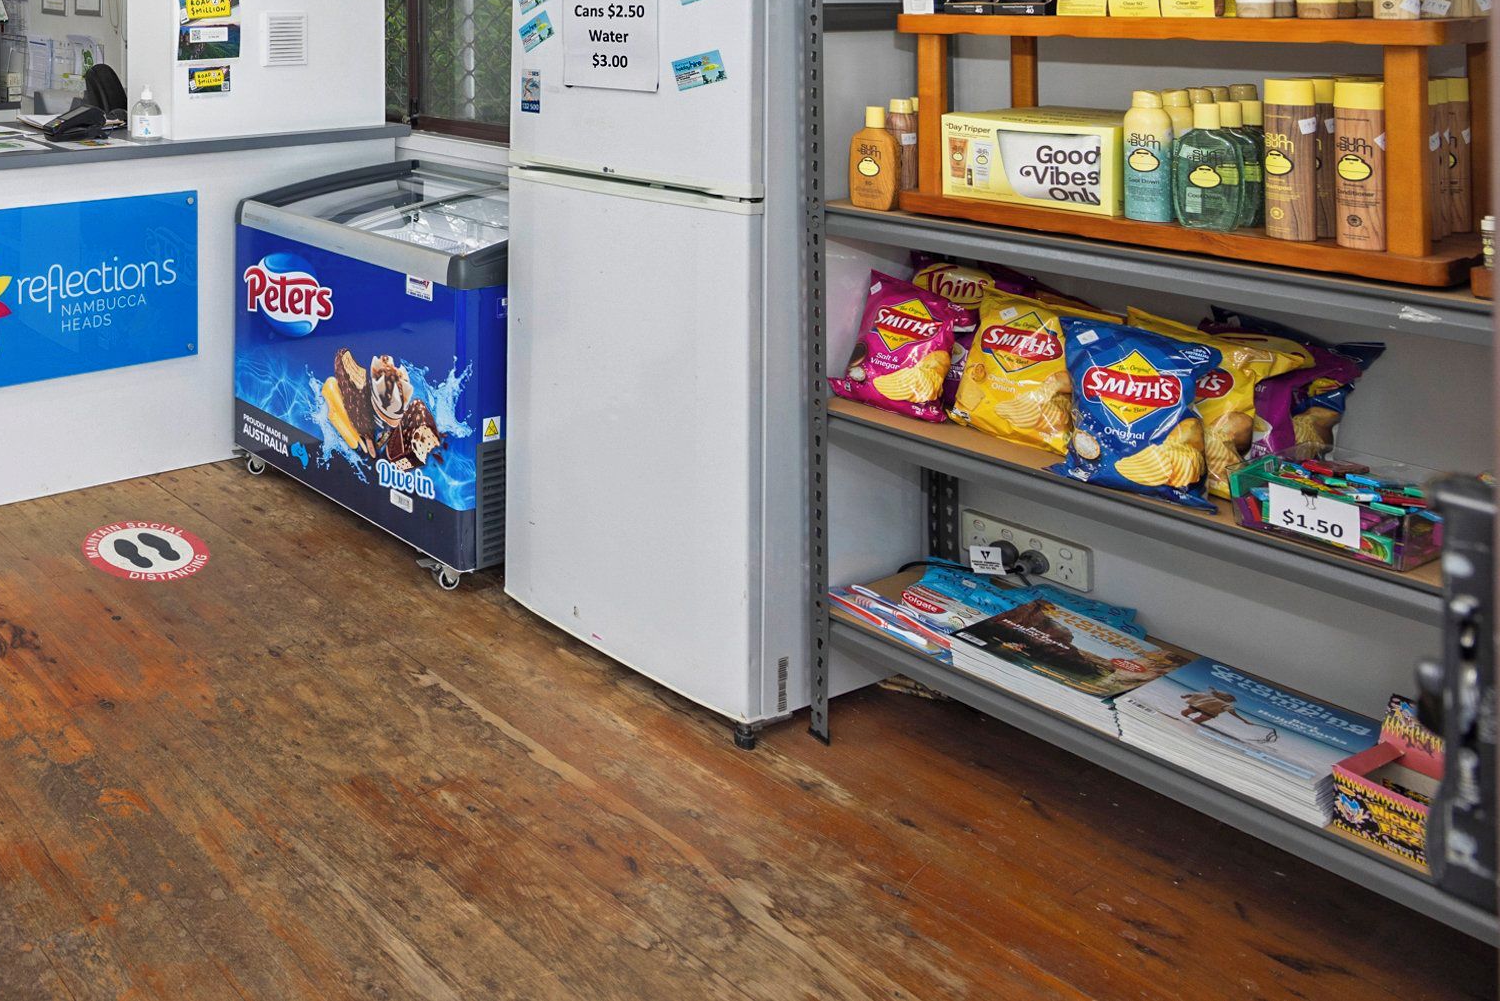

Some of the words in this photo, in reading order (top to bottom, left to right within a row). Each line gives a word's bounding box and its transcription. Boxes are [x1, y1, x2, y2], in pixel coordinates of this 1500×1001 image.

[191, 6, 226, 16] $MILLION
[574, 5, 604, 17] Cans
[608, 3, 645, 19] $2.50
[589, 30, 629, 43] Water
[592, 53, 628, 68] $3.00
[948, 123, 962, 131] Day
[964, 124, 991, 134] Tripper
[1036, 145, 1100, 164] Good
[1020, 165, 1099, 186] Vibes
[17, 257, 176, 313] reflections
[245, 267, 332, 318] Peters
[920, 266, 988, 298] Thins
[62, 294, 146, 316] NAMBUCCA
[62, 316, 112, 332] HEADS
[874, 309, 938, 337] SMITH'S
[984, 328, 1056, 357] SMITH'S
[870, 357, 900, 370] Vinegar
[876, 352, 891, 361] Salt
[991, 383, 1016, 394] Onion
[1087, 371, 1174, 401] SMITH'S
[243, 414, 265, 430] PROUDLY
[266, 426, 282, 439] MADE
[282, 433, 288, 443] IN
[1104, 426, 1145, 440] Original
[243, 424, 289, 457] AUSTRALIA
[377, 460, 413, 492] Dive
[416, 470, 434, 498] in
[1282, 509, 1343, 538] $1.50
[86, 524, 122, 559] MAINTAIN
[126, 522, 183, 536] SOCIAL
[129, 554, 208, 580] DISTANCING
[902, 592, 938, 612] Colgate
[1368, 802, 1424, 832] WICKE
